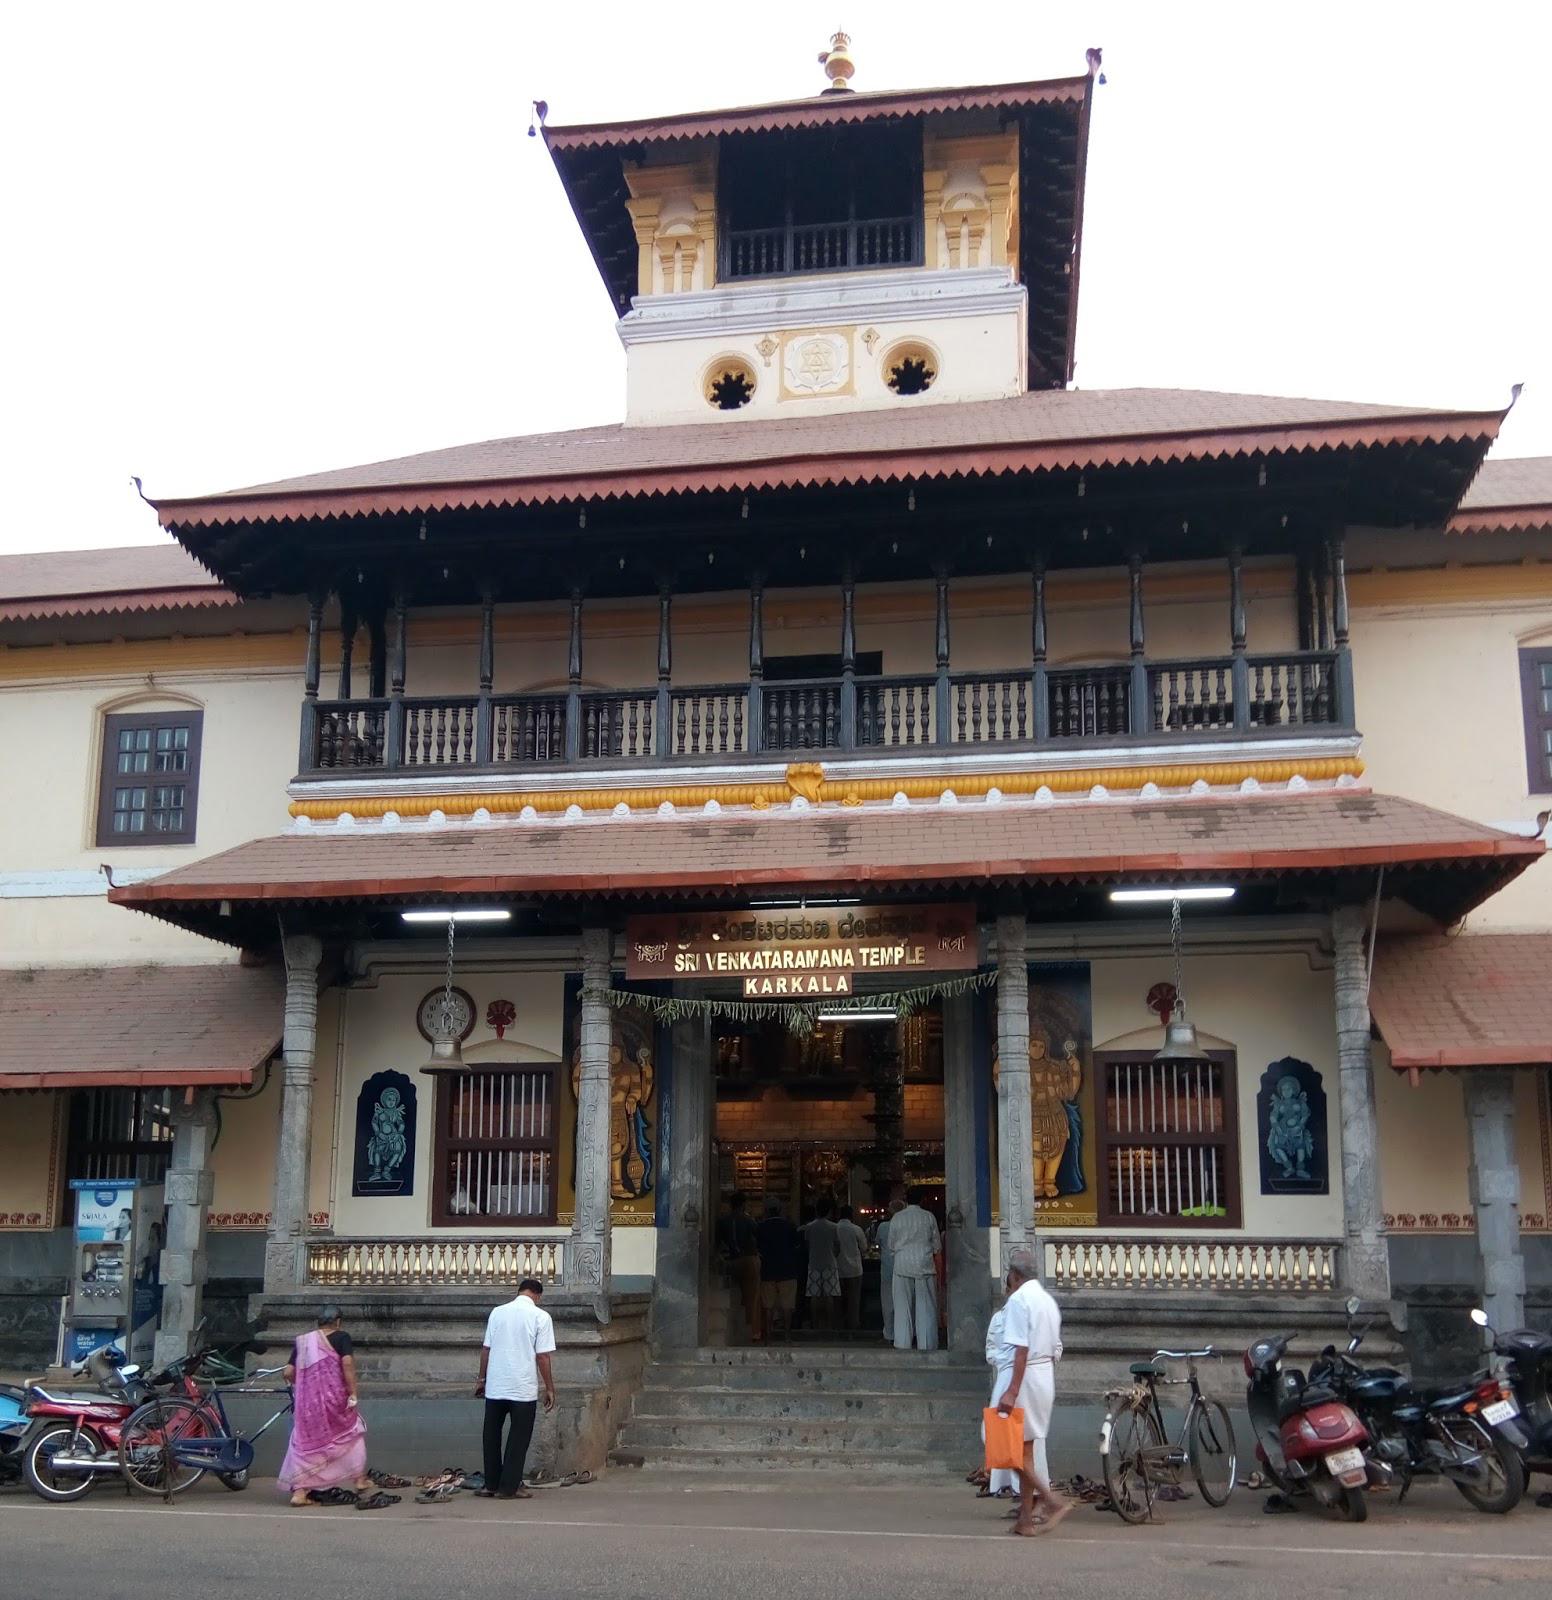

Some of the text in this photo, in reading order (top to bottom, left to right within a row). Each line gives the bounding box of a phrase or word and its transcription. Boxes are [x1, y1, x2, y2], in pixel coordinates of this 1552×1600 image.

[674, 946, 926, 972] SRI VENKATARAMANA TEMPLE
[745, 975, 849, 995] KARKALA
